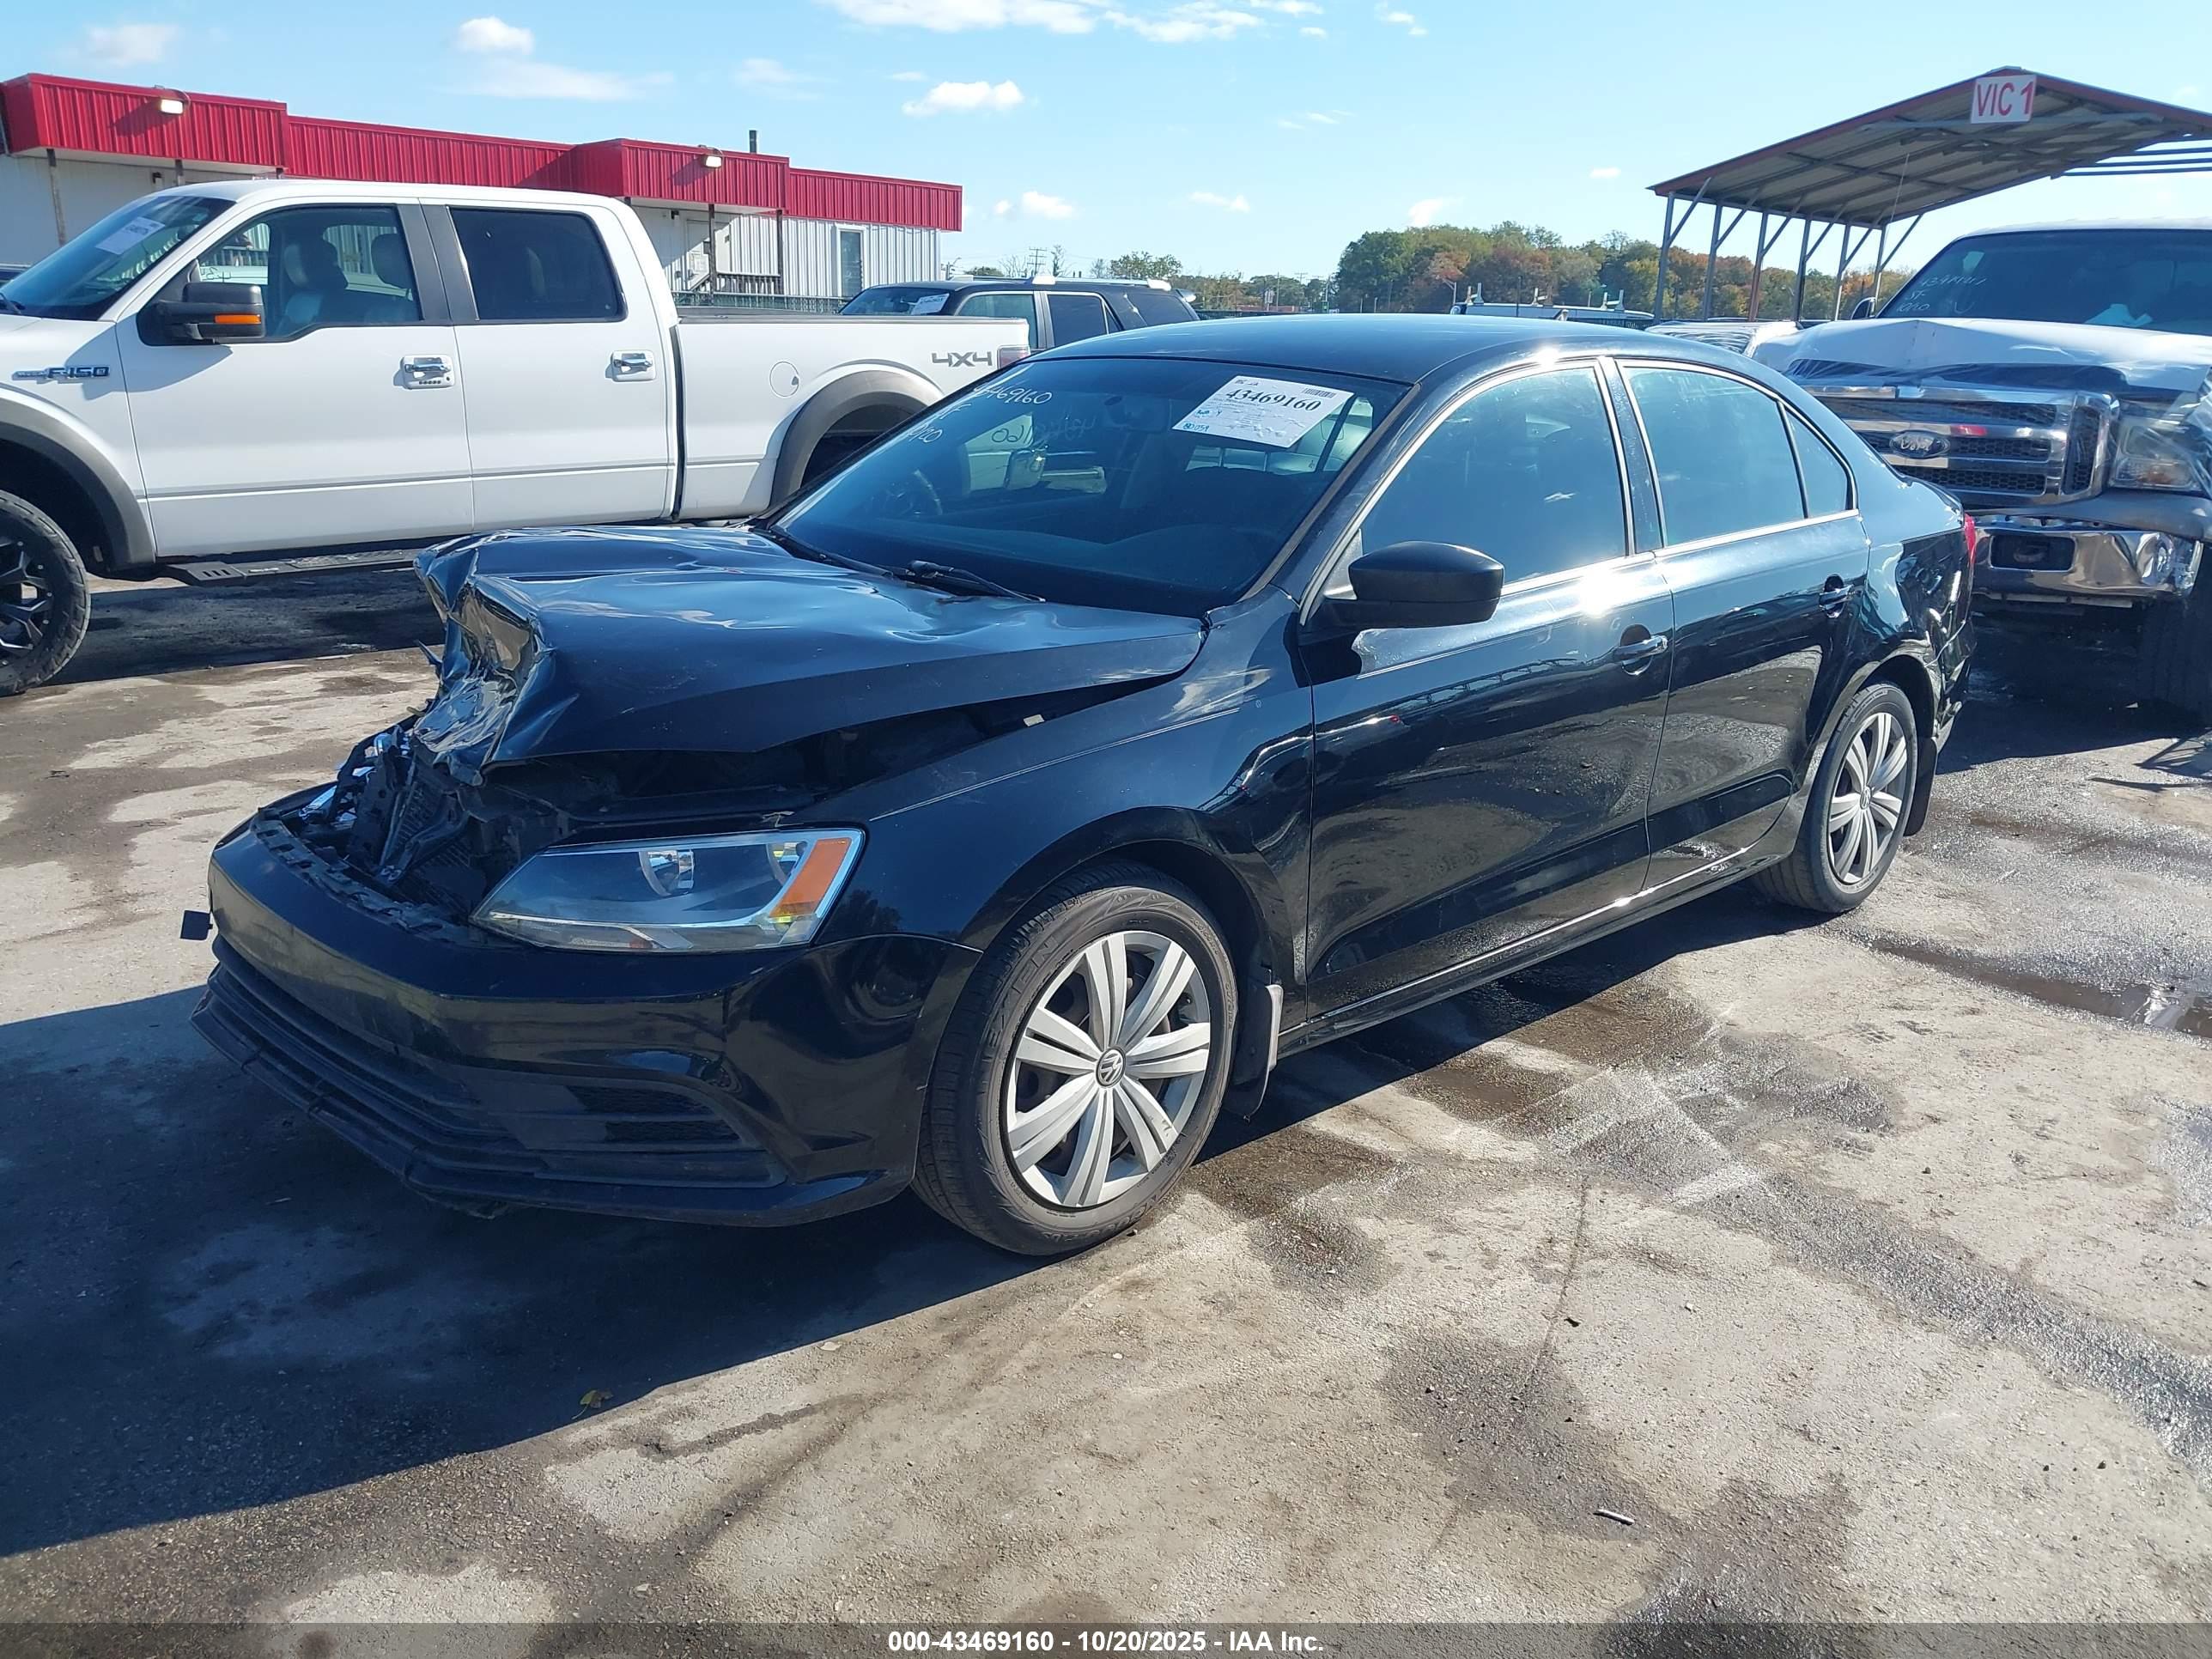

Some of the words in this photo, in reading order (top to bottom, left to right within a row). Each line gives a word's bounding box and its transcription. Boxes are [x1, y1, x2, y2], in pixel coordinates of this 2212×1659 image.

[1977, 82, 2014, 116] VIC
[2021, 82, 2033, 114] 1
[1226, 388, 1322, 411] 43469160
